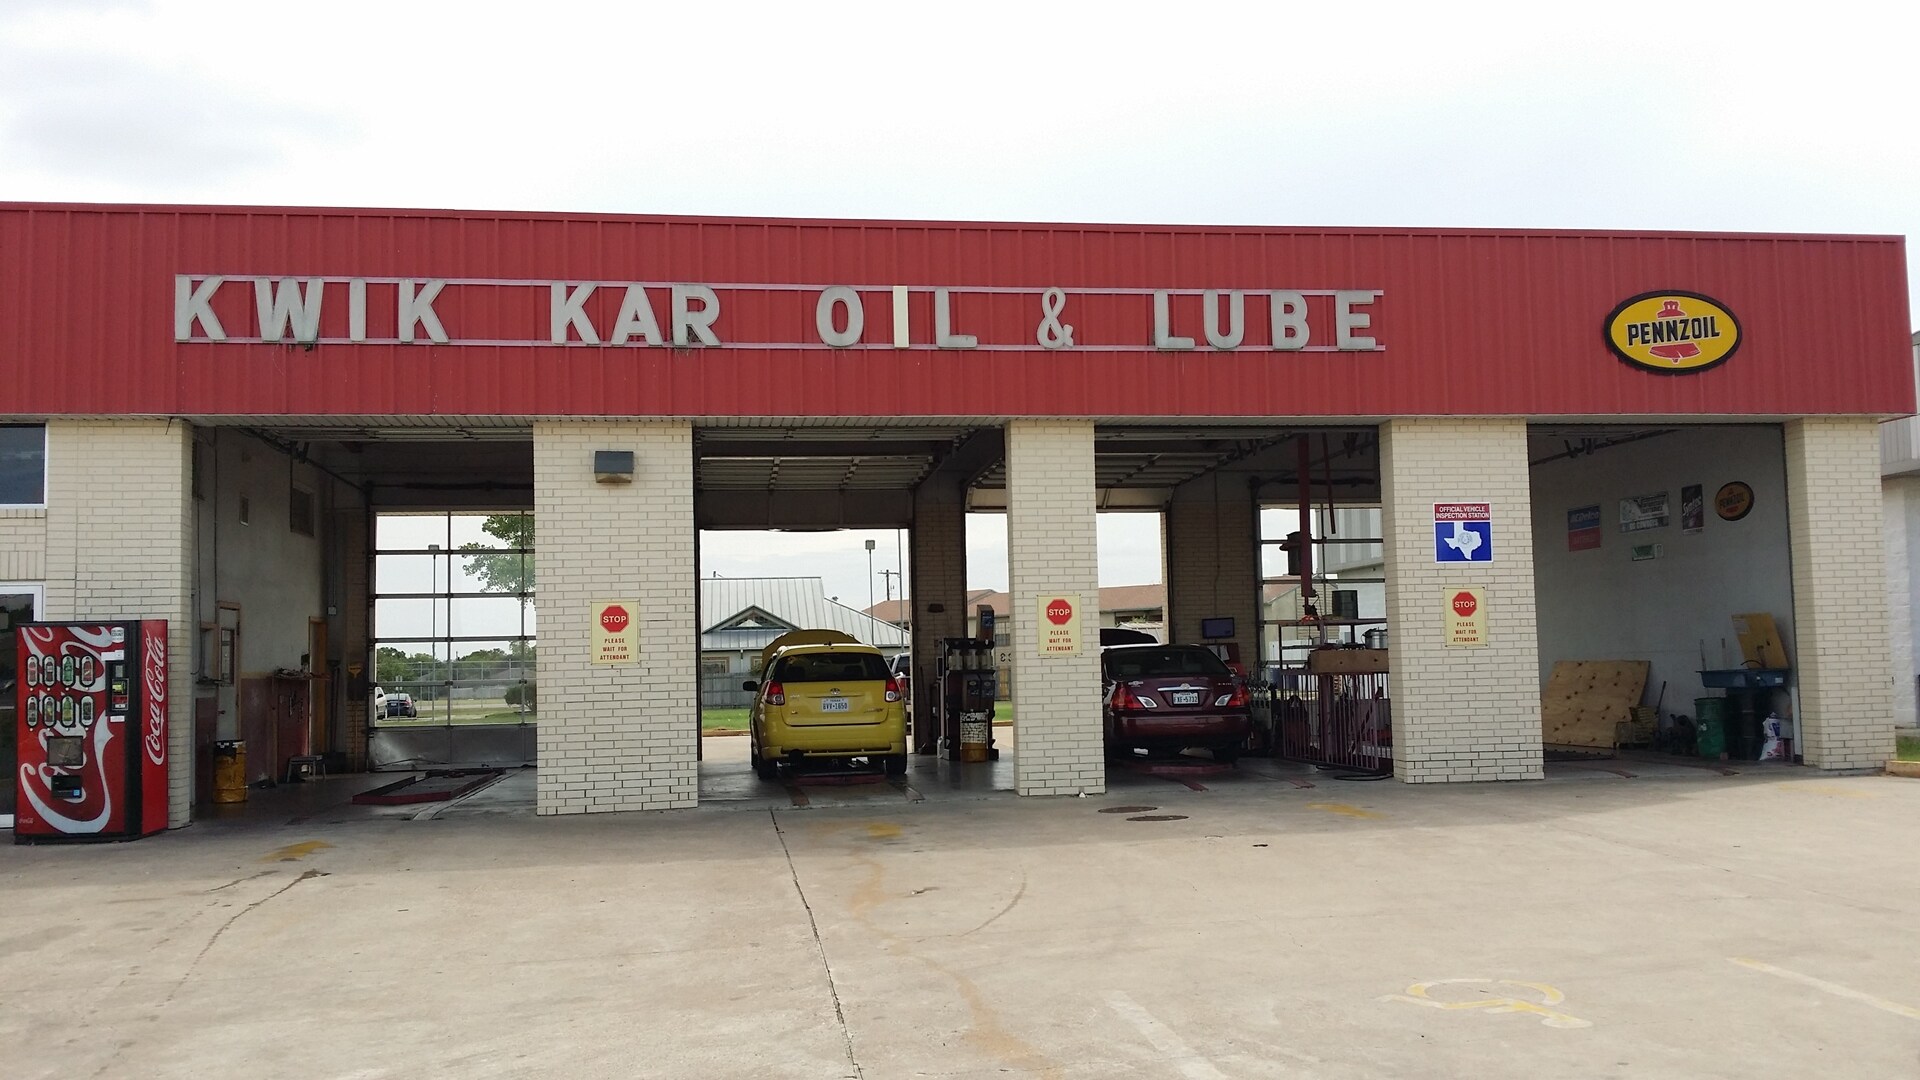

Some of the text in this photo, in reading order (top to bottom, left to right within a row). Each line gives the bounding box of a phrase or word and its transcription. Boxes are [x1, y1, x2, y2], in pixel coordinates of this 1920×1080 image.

[174, 276, 1377, 350] KWIK KAR OIL & LUBE
[1627, 316, 1720, 346] PENNZOIL
[602, 615, 627, 623] STOP
[1048, 608, 1070, 616] STOP
